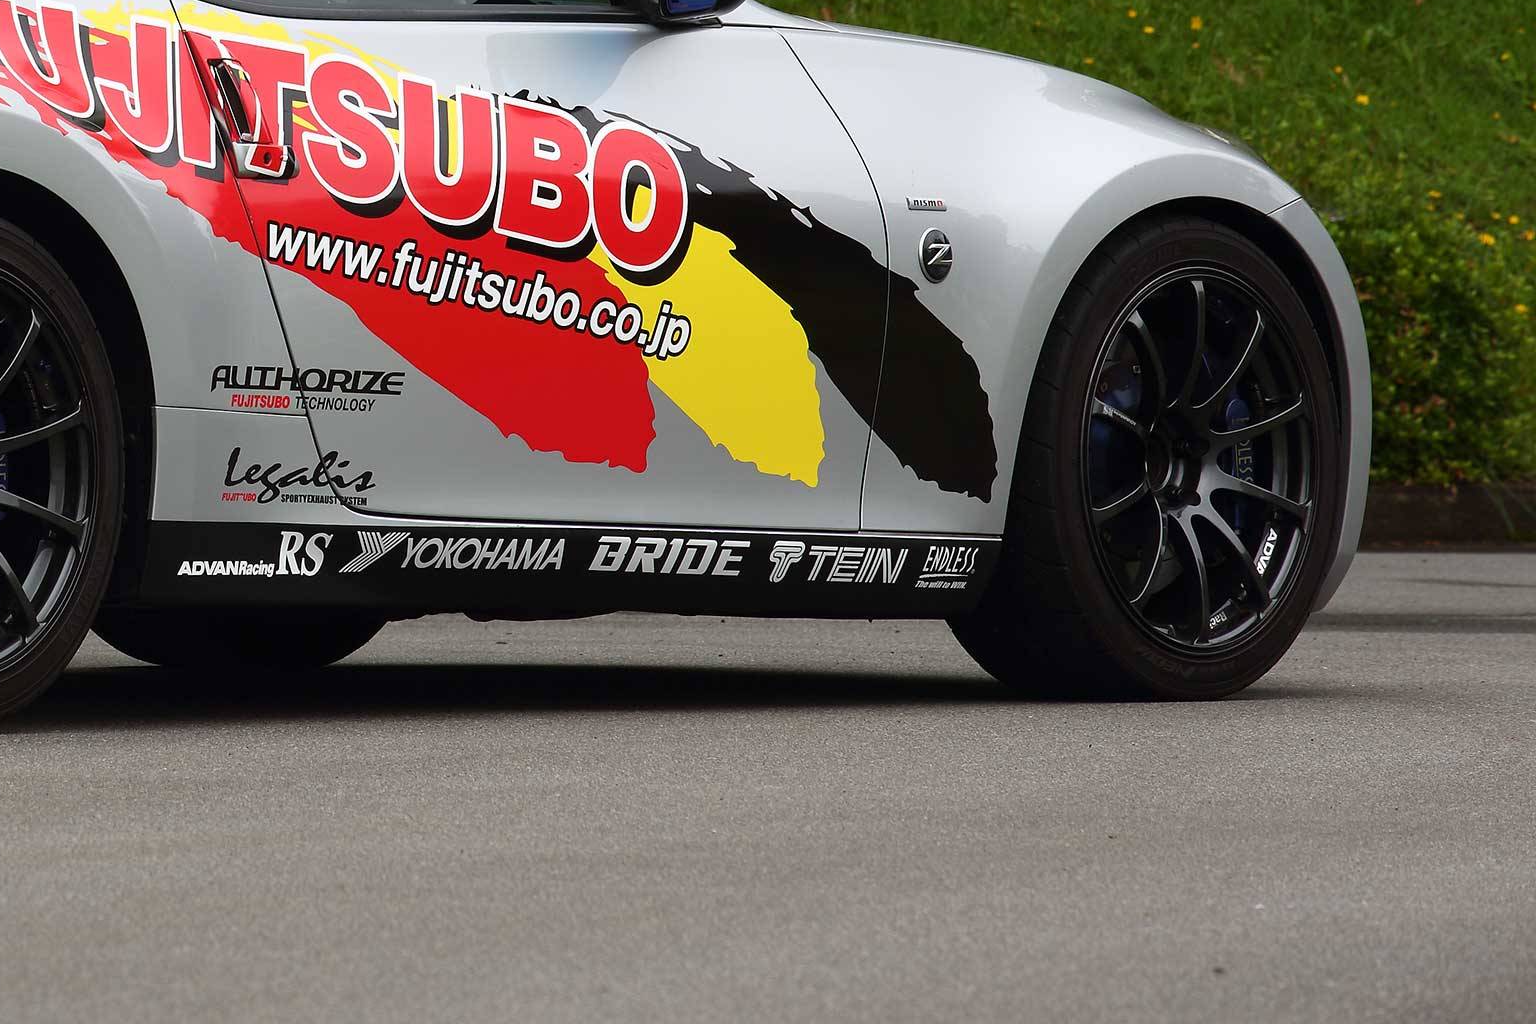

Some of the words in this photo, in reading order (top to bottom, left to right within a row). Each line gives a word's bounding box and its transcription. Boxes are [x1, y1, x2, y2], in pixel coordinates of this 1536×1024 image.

[913, 199, 944, 208] nismo
[267, 222, 692, 358] www.fujitsubo.co.jp
[210, 365, 406, 395] AUTHORIZE
[231, 394, 291, 409] FUJITSUBO
[295, 396, 376, 412] TECHNOLOGY
[224, 447, 376, 504] Legalis
[275, 531, 333, 576] RS
[401, 538, 565, 570] YOKOHAMA
[588, 536, 751, 576] BRIDE
[807, 545, 909, 584] TEIN
[922, 545, 979, 573] ENDLESS
